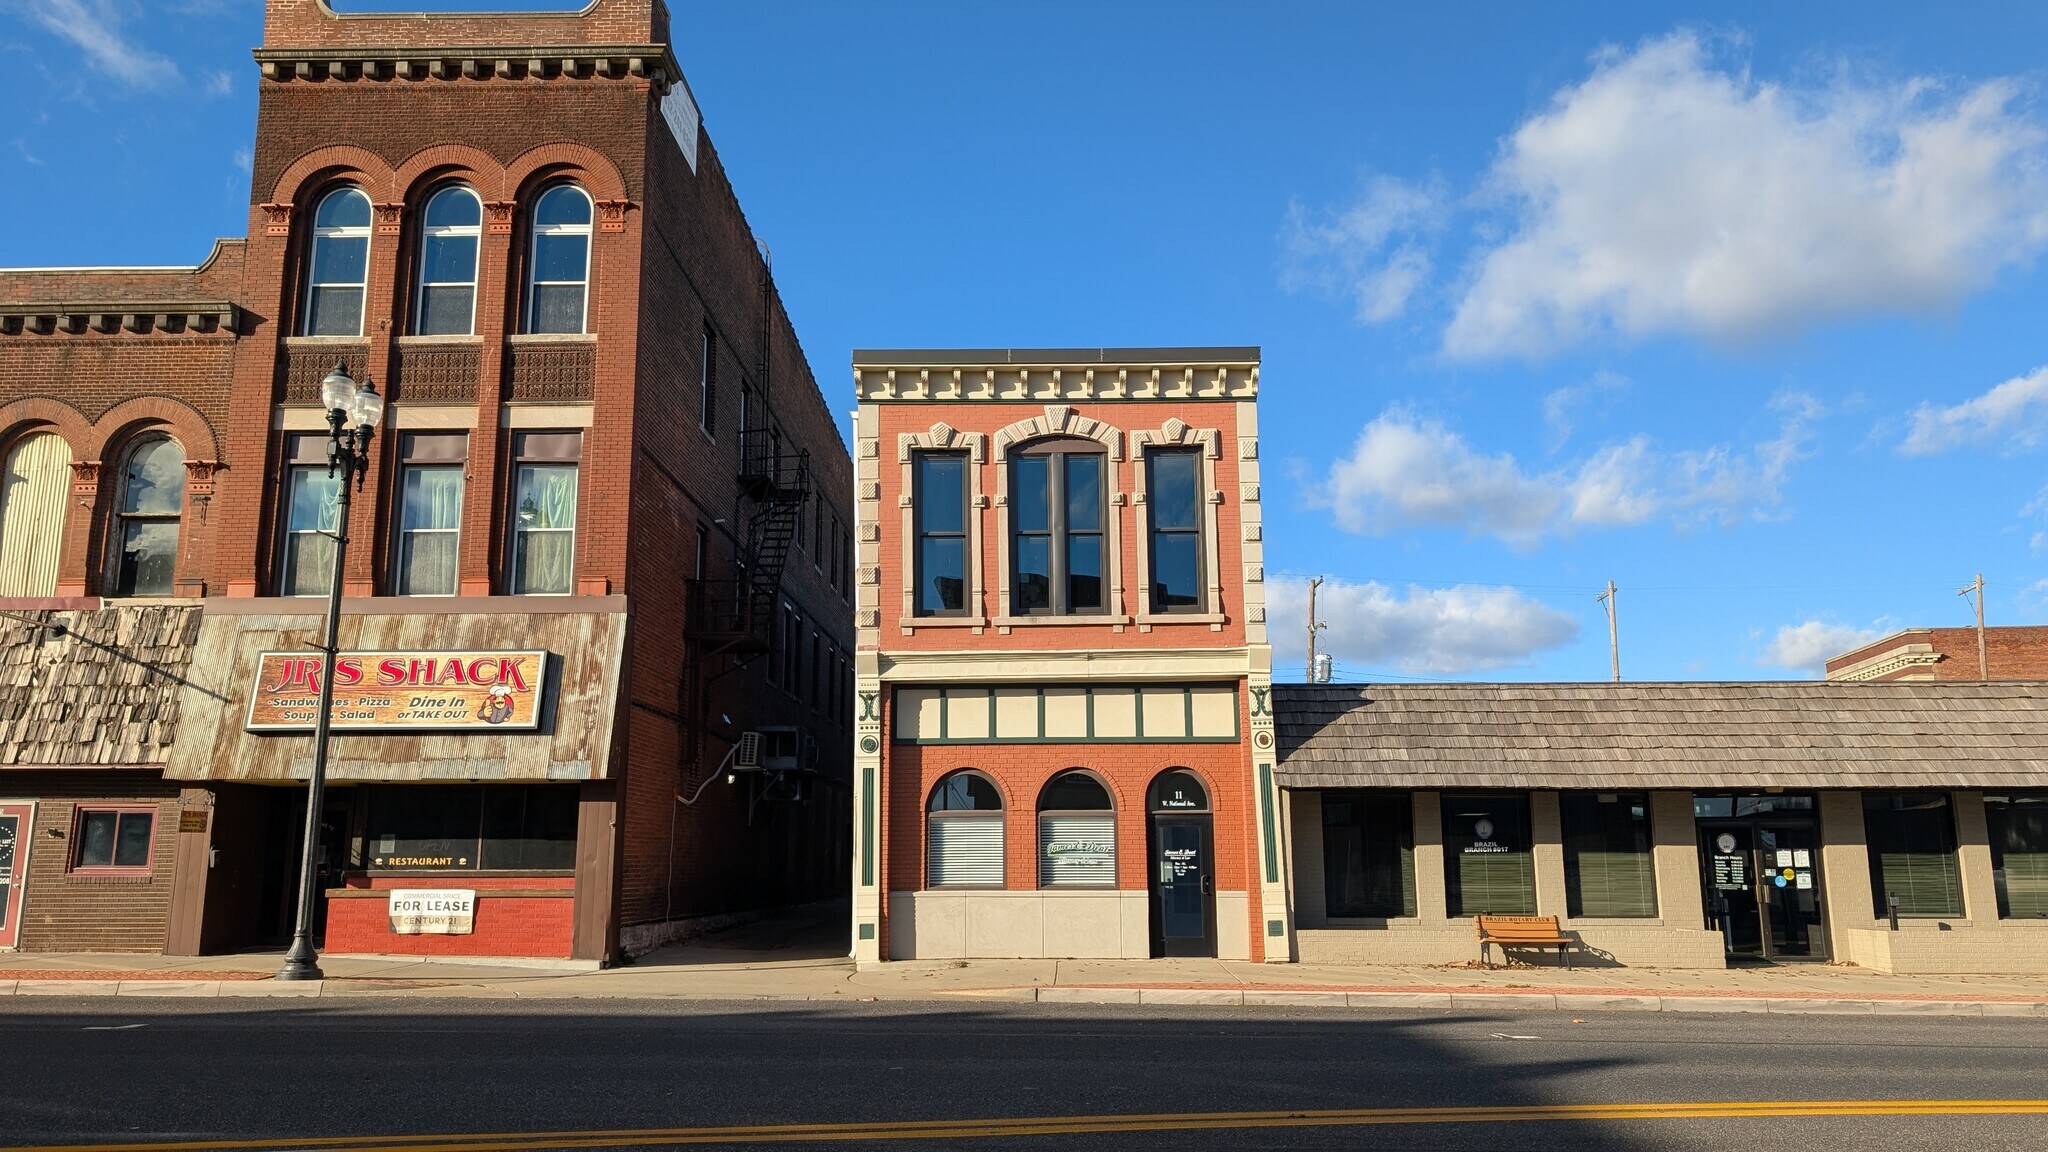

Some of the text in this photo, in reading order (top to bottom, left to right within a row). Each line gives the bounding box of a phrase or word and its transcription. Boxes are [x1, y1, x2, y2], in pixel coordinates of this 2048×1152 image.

[267, 657, 530, 695] JRS SHACK
[273, 697, 391, 707] Sandwies Pizza
[409, 695, 466, 708] Dine In
[340, 710, 376, 720] Salad
[397, 711, 469, 719] or TAKE OUT
[1174, 790, 1183, 800] 11
[418, 840, 451, 852] OPEN
[388, 857, 453, 866] RESTAURANT
[394, 901, 470, 911] FOR LEASE
[403, 917, 457, 925] CENTURY 21
